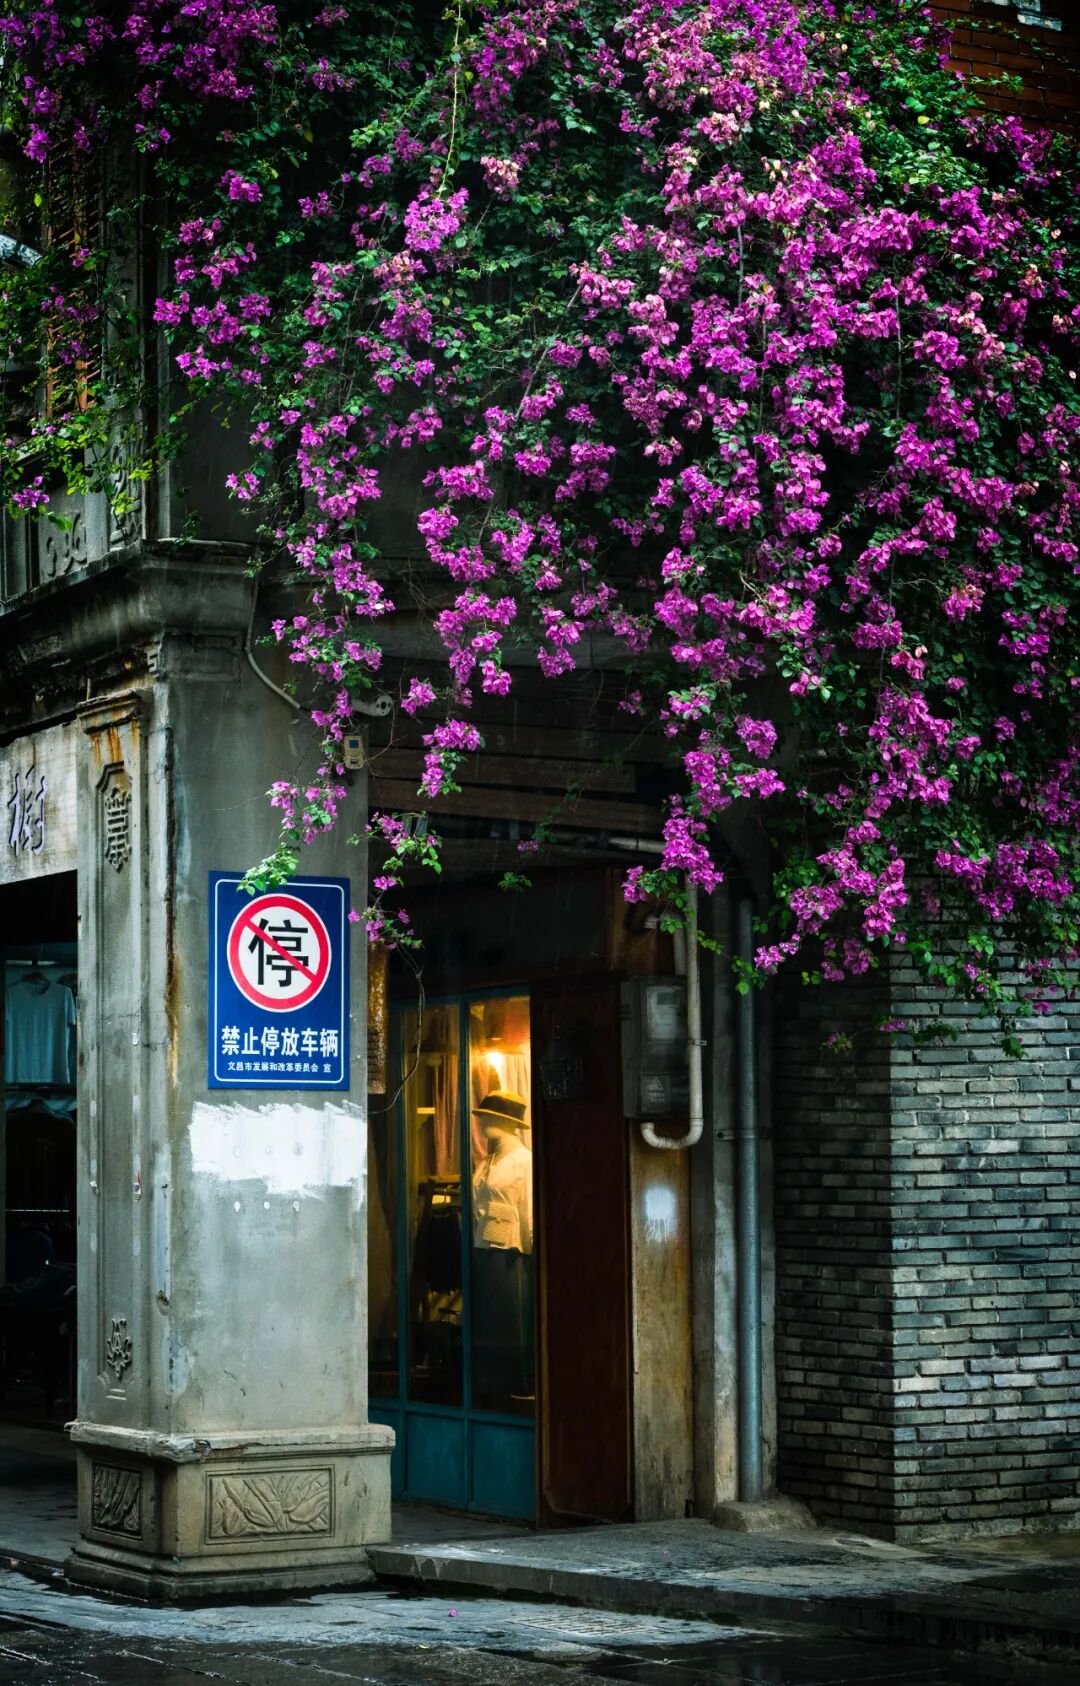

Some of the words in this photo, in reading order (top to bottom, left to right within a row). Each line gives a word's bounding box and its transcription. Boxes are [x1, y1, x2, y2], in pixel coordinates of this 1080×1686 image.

[248, 917, 309, 988] 停
[221, 1025, 339, 1058] 禁止停放车辆
